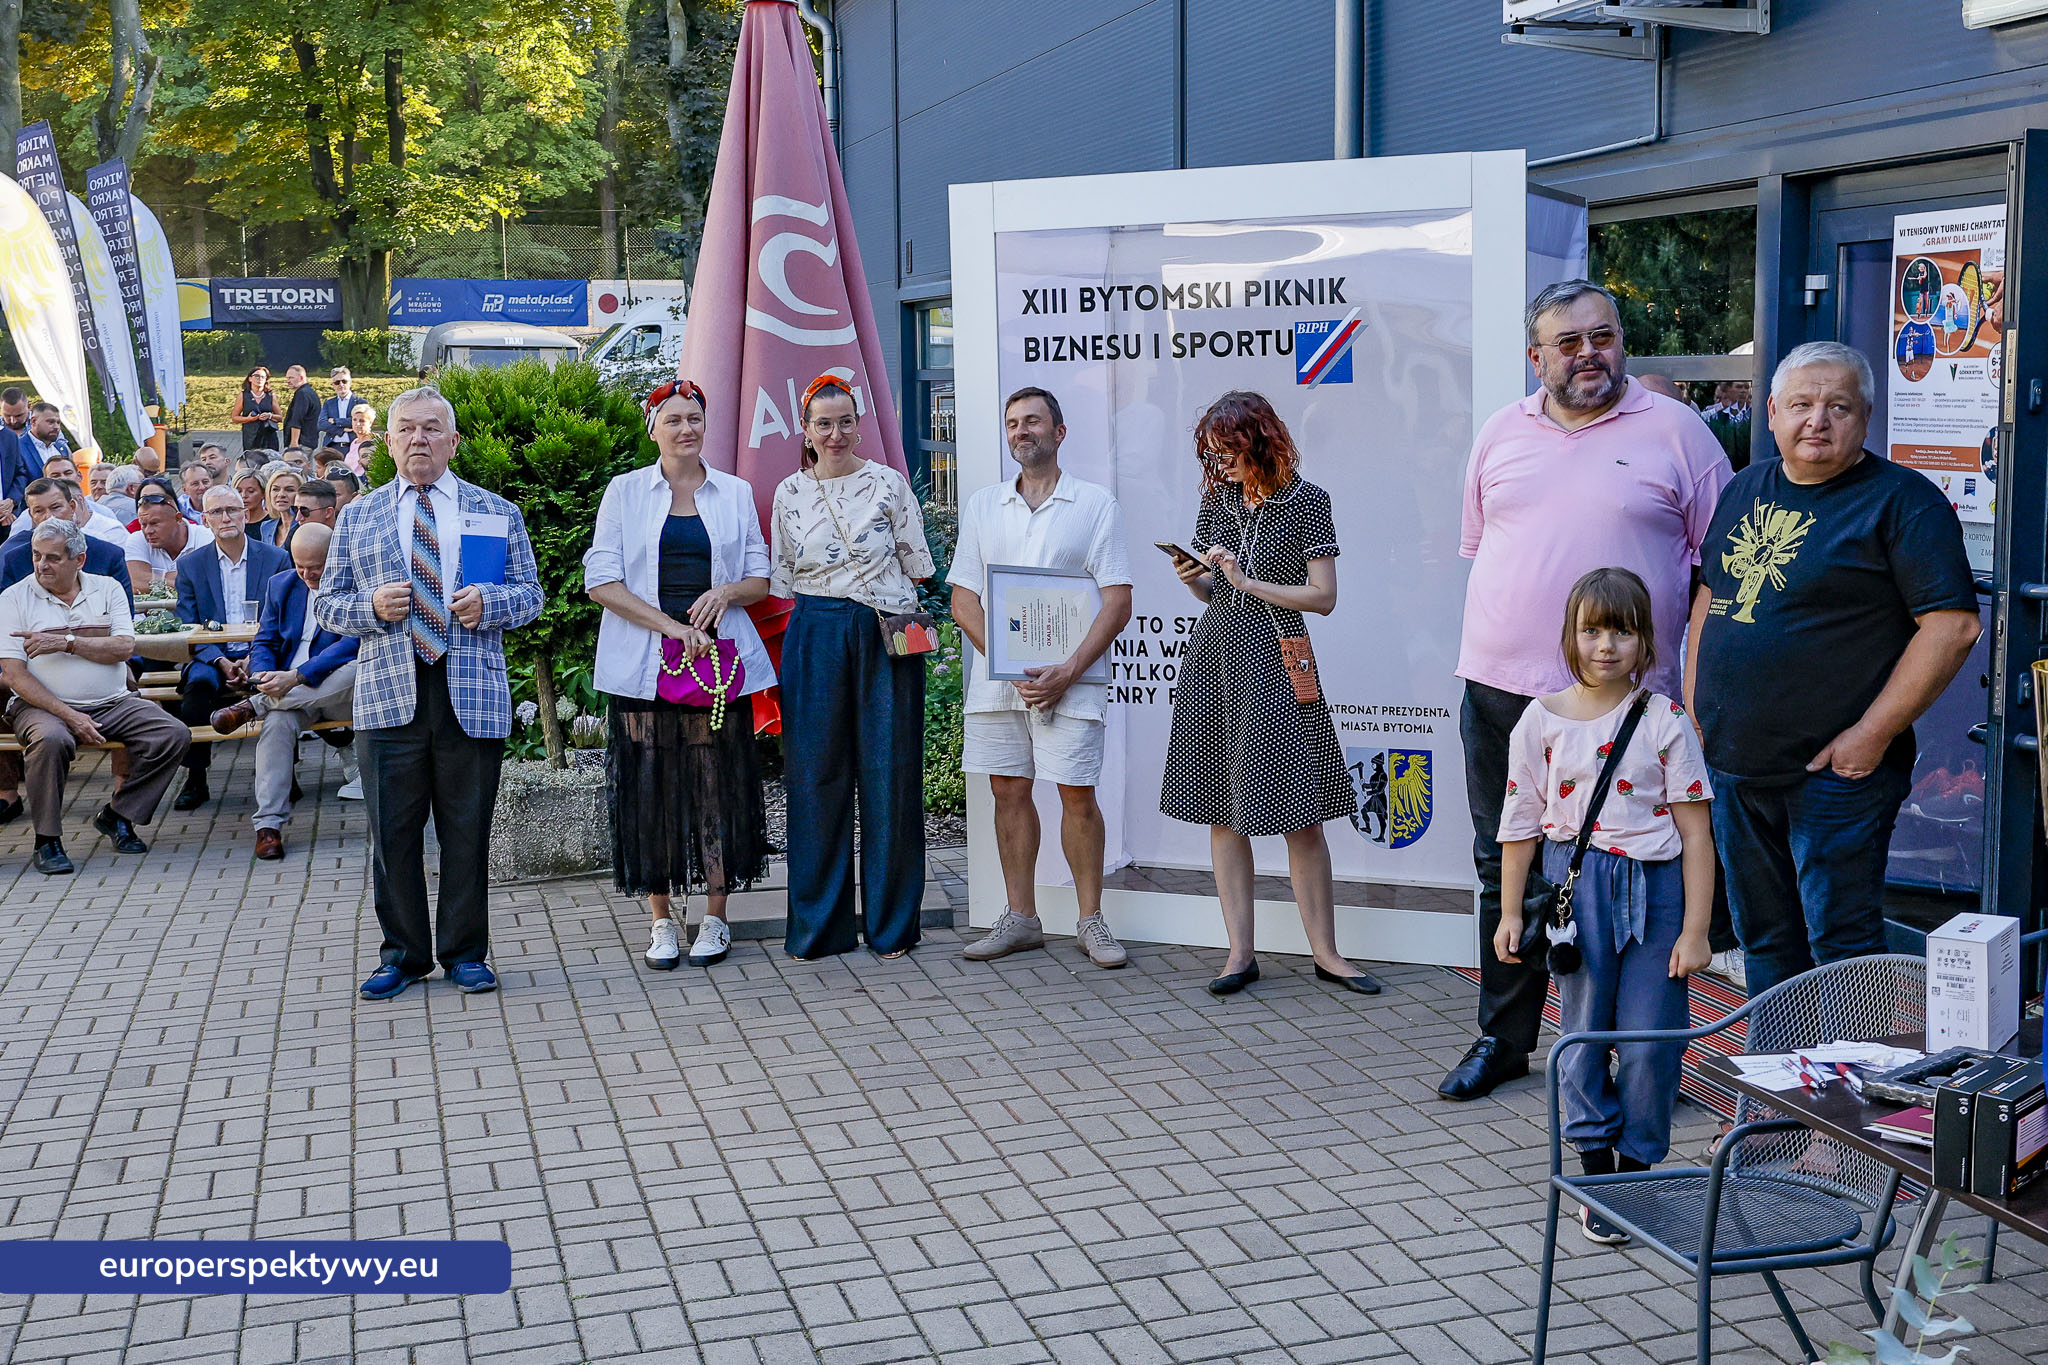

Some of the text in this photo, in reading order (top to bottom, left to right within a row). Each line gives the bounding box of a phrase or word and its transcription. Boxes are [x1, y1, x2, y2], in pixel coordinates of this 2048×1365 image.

[1900, 219, 2006, 237] VI TENISOWY TURNIEJ CHARYTAT
[1953, 235, 1967, 244] DLA
[219, 288, 334, 304] TRETORN
[508, 294, 574, 306] metalplast
[1022, 276, 1348, 315] XIII BYTOMSKI PIKNIK
[1296, 321, 1330, 334] BIPH
[504, 337, 524, 345] TAXI
[1024, 329, 1294, 362] BIZNESU I SPORTU
[1969, 532, 1992, 542] KORTÓW
[1136, 616, 1198, 635] TO SZ
[1114, 639, 1190, 658] NIA WA
[1111, 663, 1176, 682] TYLKO
[1108, 686, 1158, 705] ENRY
[1328, 704, 1451, 718] ATRONAT PREZYDENTA
[1341, 721, 1434, 734] MIASTA BYTOMIA
